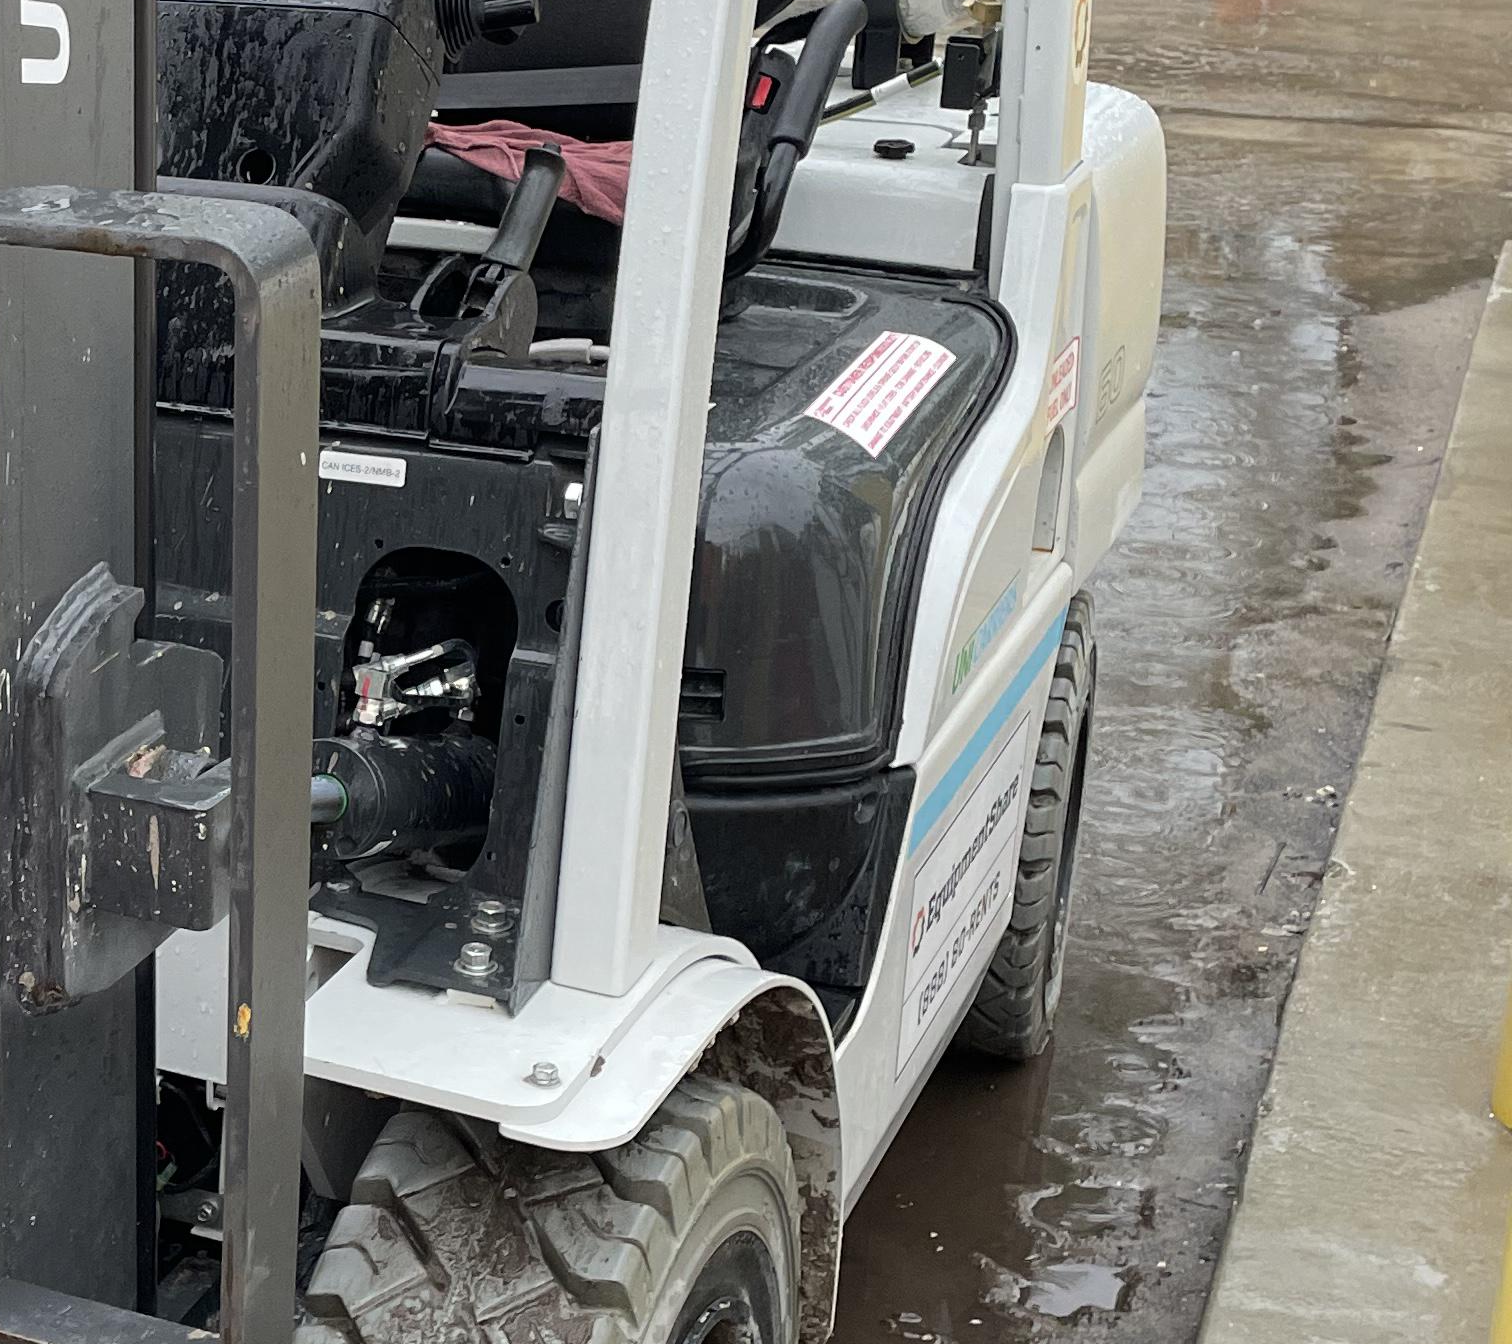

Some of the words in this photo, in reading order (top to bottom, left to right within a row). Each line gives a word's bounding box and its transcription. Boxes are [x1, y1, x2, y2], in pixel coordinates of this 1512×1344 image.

[321, 461, 339, 470] CAN
[926, 773, 1019, 932] EquipmentShare
[918, 950, 949, 1026] (888)
